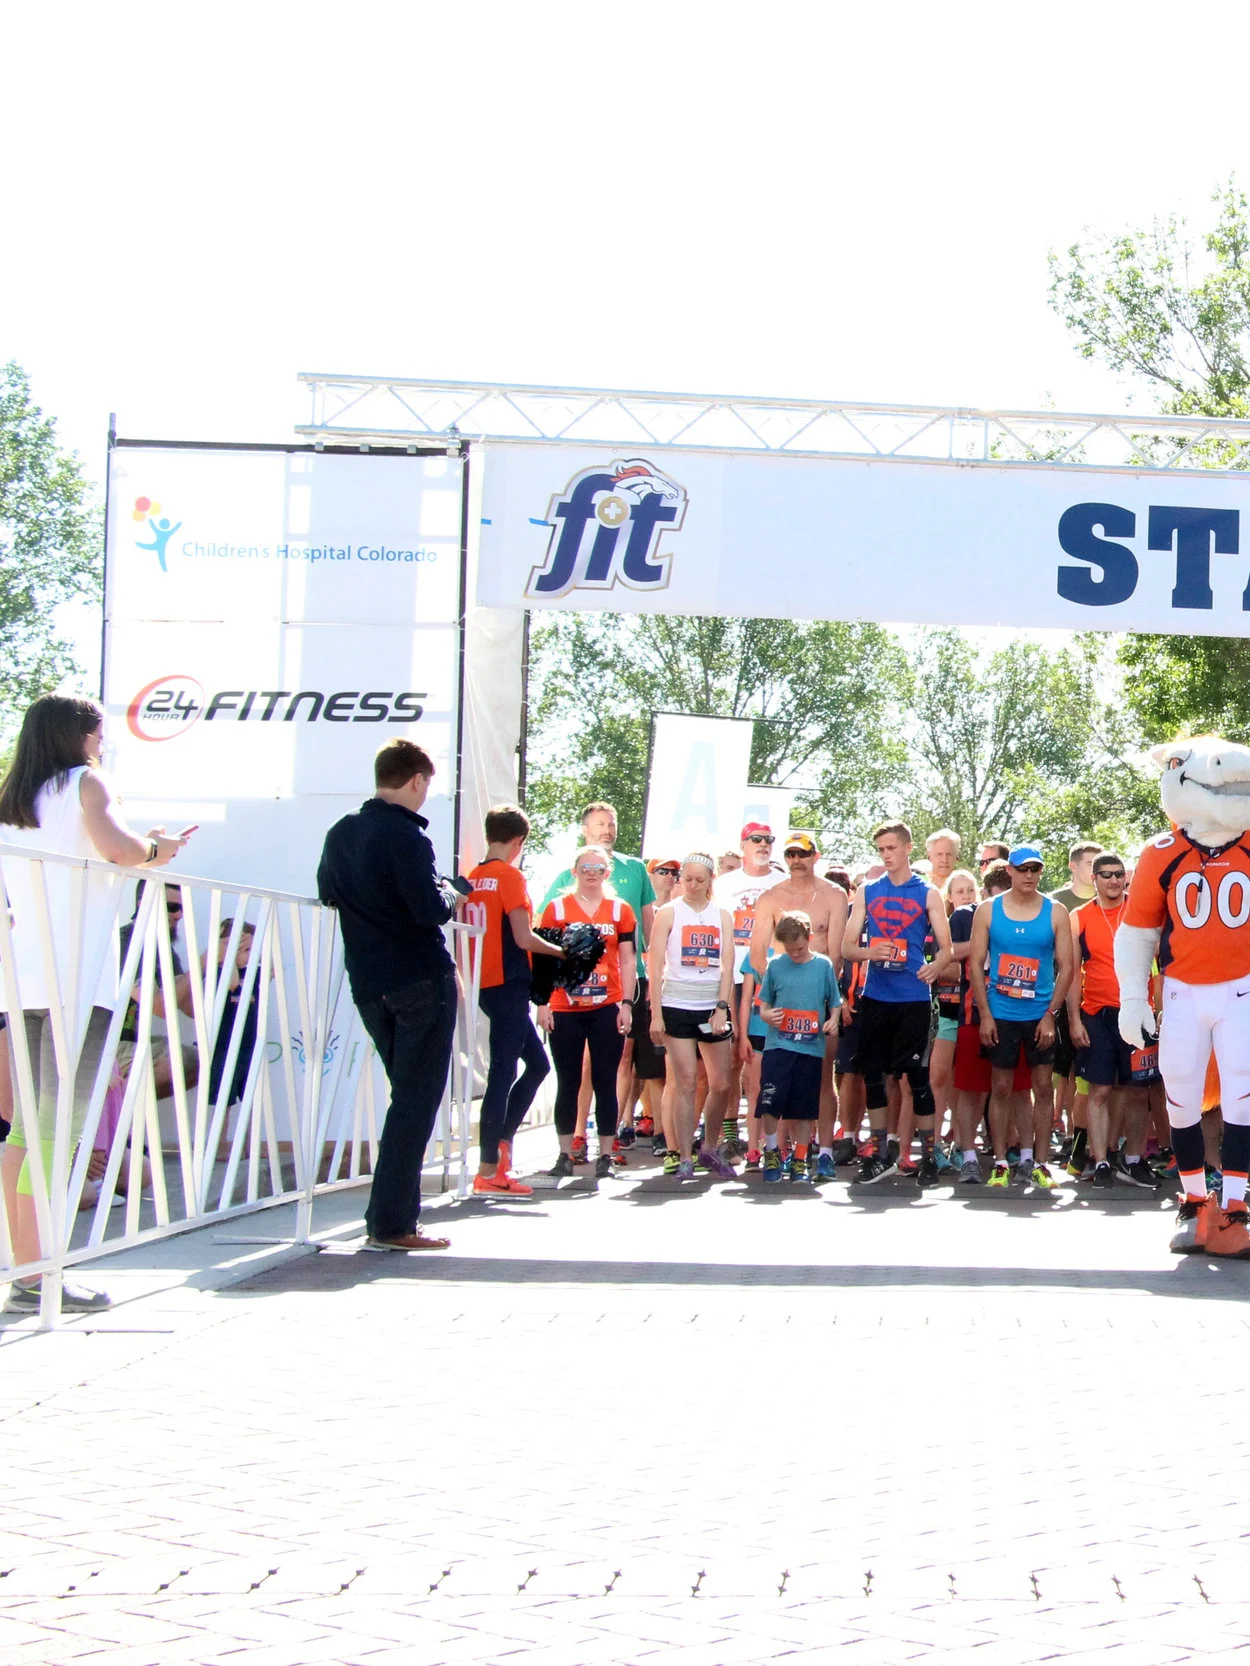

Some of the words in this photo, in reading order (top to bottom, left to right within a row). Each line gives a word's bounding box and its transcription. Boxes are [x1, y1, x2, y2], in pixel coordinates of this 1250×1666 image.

[533, 471, 680, 593] fit
[182, 541, 270, 559] Children's
[276, 543, 351, 563] Hospital
[357, 545, 437, 563] Colorado
[145, 690, 200, 721] 24
[204, 690, 428, 723] FITNESS
[141, 712, 180, 721] HOUR
[690, 932, 714, 948] 630
[1007, 962, 1032, 980] 261
[787, 1017, 811, 1032] 348
